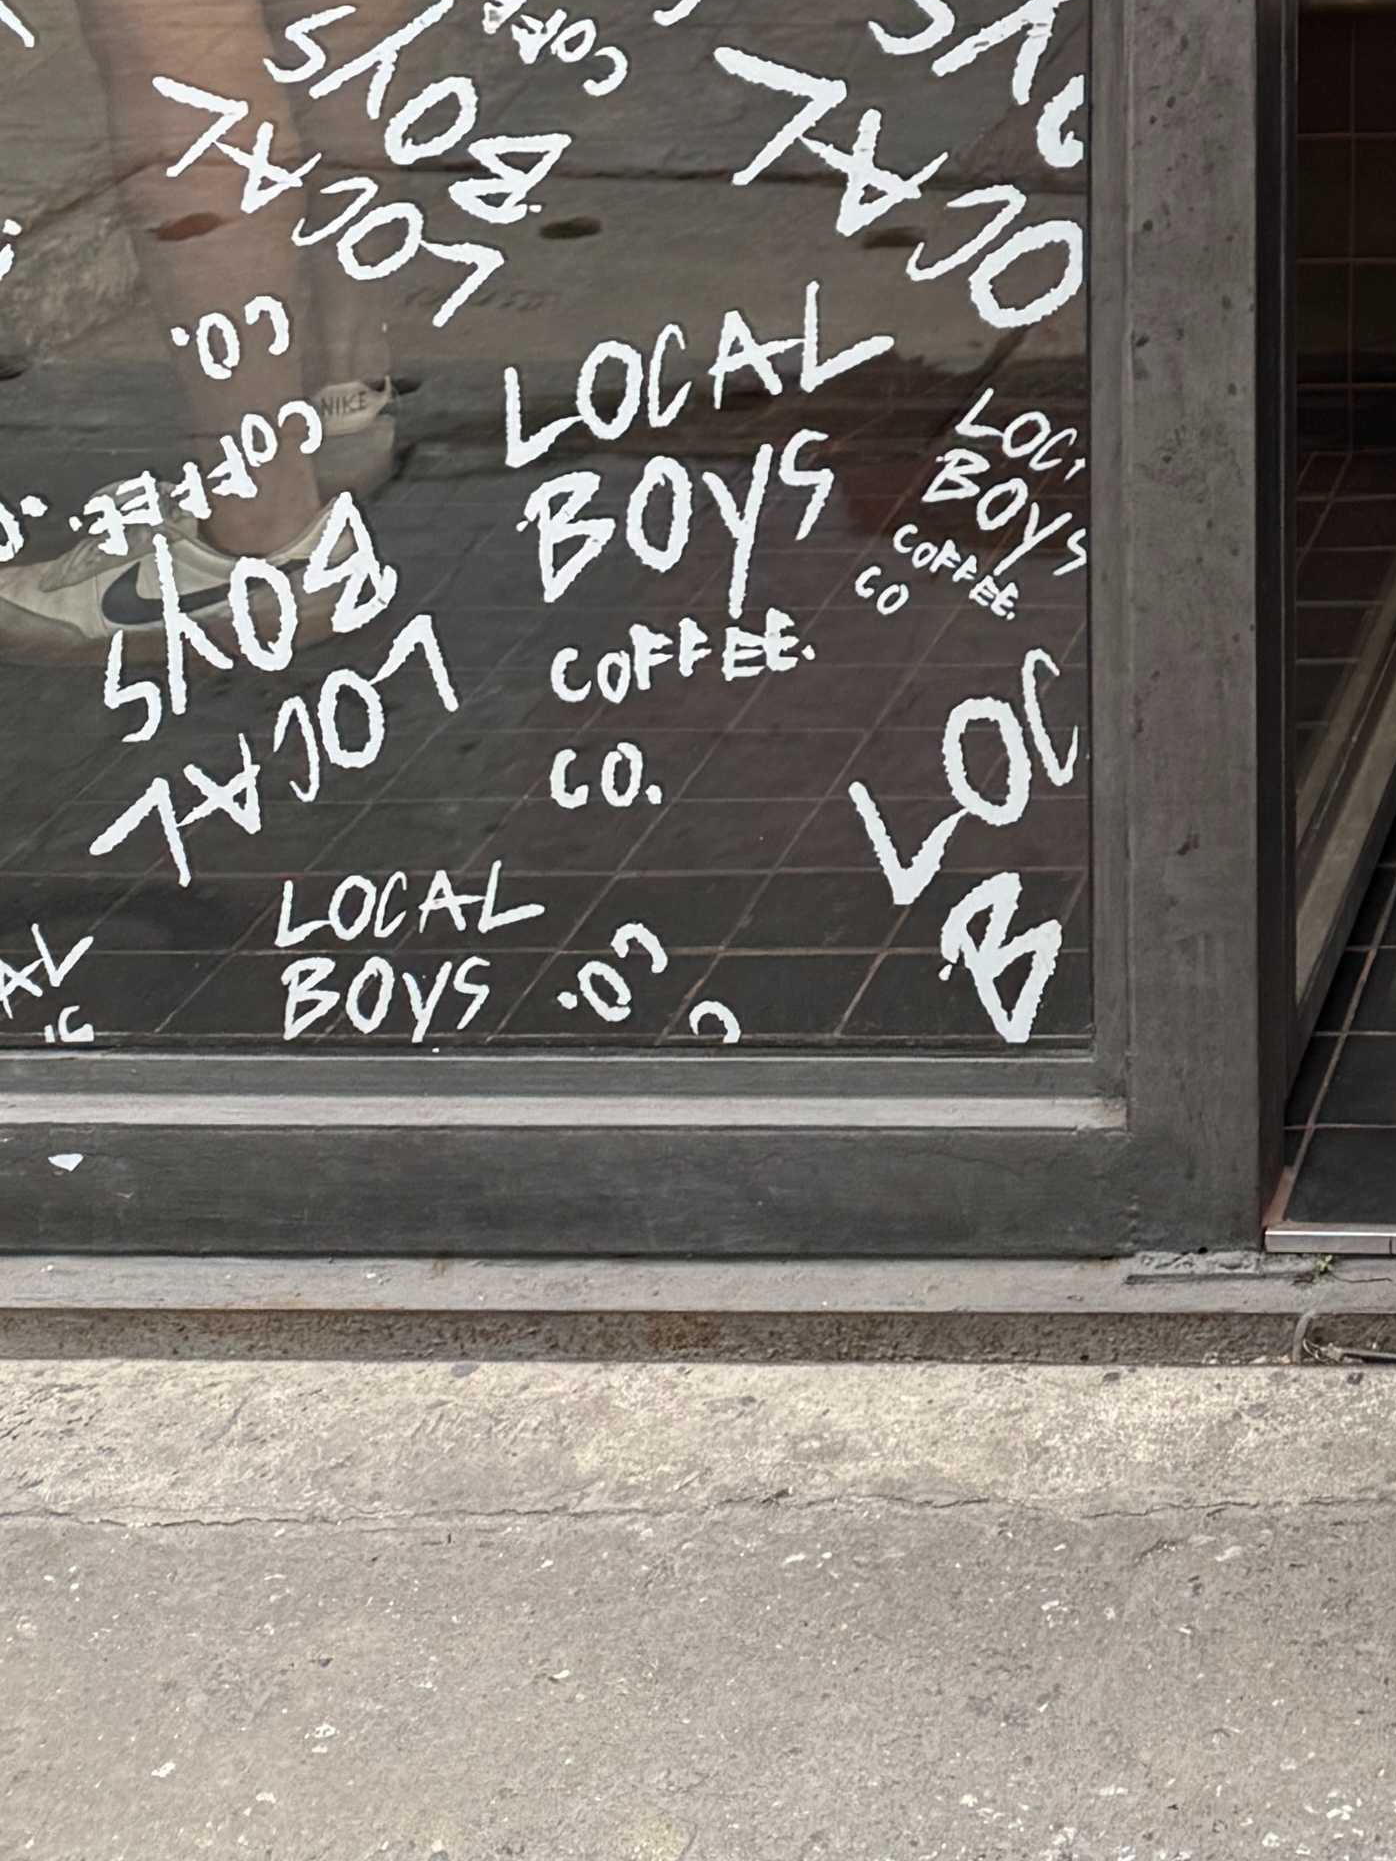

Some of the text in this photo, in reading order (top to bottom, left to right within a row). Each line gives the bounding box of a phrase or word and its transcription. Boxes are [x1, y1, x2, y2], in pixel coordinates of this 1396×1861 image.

[151, 75, 506, 328] LOCAL
[170, 295, 290, 381] CO.
[503, 280, 895, 469] LOCAL
[68, 400, 323, 557] COFFEE.
[516, 428, 835, 620] BOYS
[921, 448, 1087, 577] BOYS
[103, 490, 398, 743] BOYS
[854, 565, 910, 616] CO
[893, 523, 1019, 622] COFFEE.
[550, 606, 816, 704] COFFEE.
[88, 613, 460, 888] LOCAL
[549, 741, 663, 810] CO.
[848, 647, 1079, 906] LOC
[274, 859, 546, 948] LOCAL
[280, 955, 491, 1044] BOYS
[556, 922, 669, 1023] CO.
